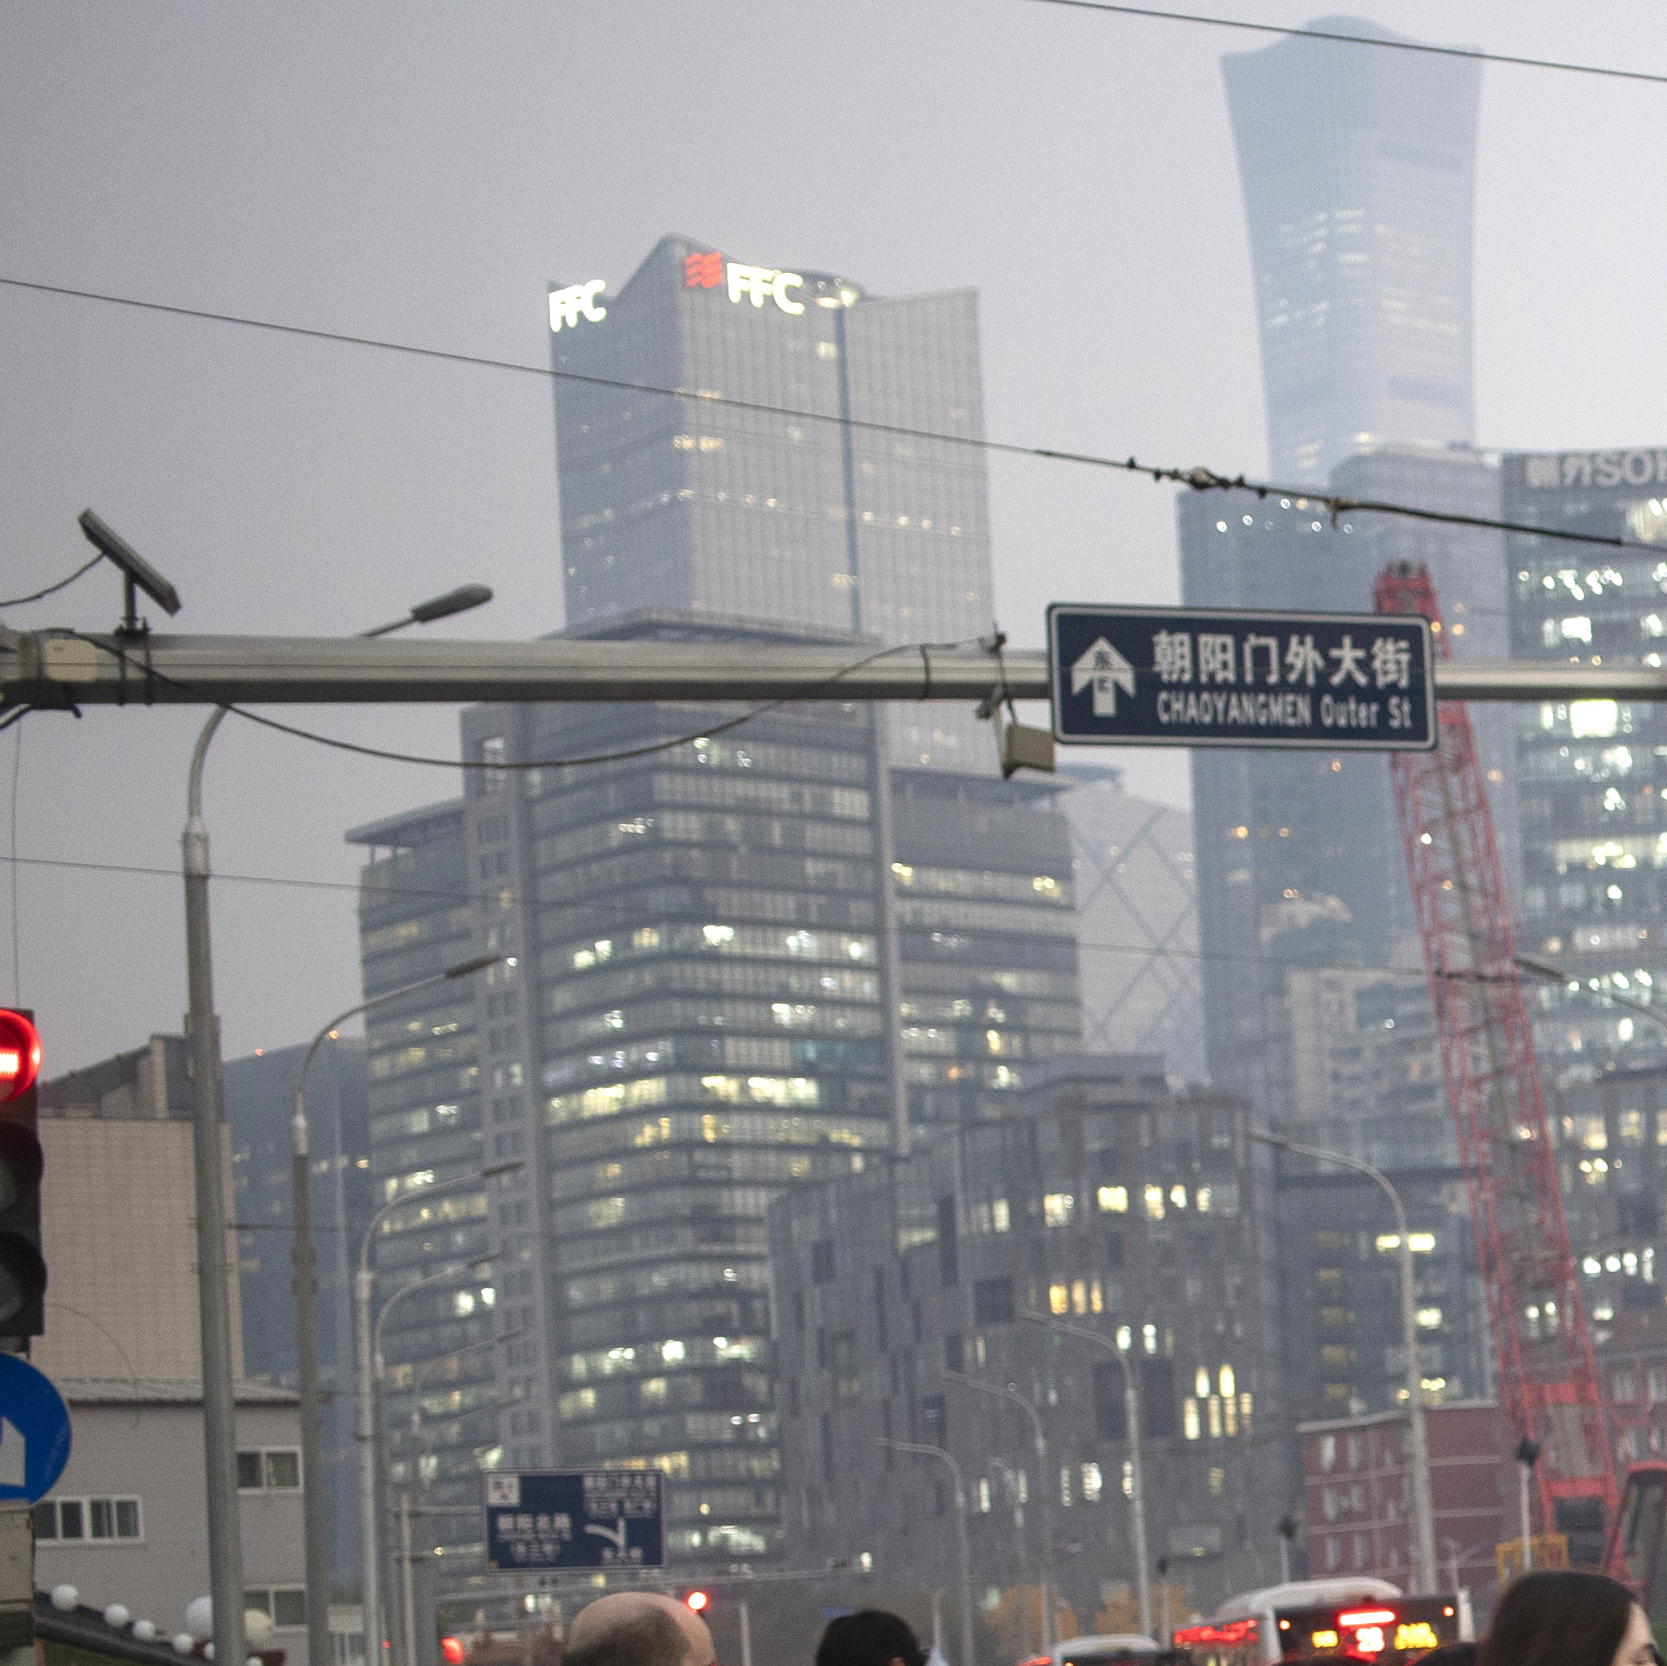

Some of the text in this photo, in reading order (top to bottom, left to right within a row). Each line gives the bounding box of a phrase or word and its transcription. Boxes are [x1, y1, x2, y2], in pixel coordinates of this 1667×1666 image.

[549, 280, 607, 333] FFC
[726, 262, 805, 316] FFC
[1152, 630, 1412, 689] 朝阳门外大街
[1157, 691, 1412, 729] CHAOYANGMEN Outer St
